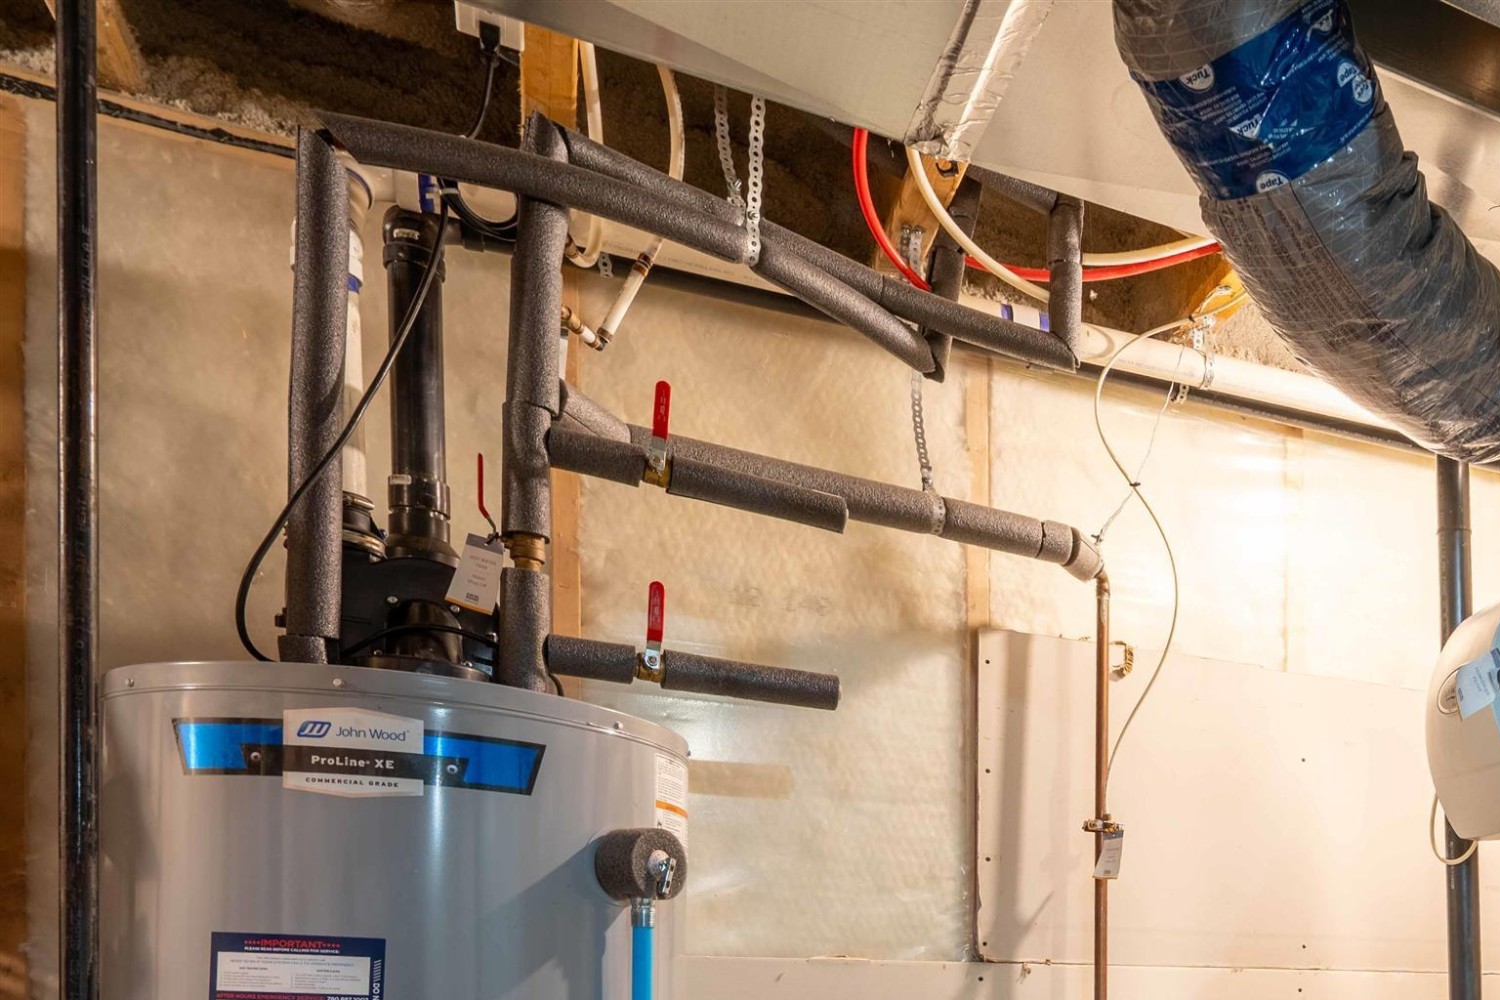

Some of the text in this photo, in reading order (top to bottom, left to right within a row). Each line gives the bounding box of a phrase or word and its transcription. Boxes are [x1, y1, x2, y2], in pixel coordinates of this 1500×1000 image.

[1185, 66, 1211, 86] Tuck
[336, 726, 406, 741] John Wood
[374, 759, 395, 769] XE
[305, 777, 364, 785] COMMERCIAL
[260, 939, 323, 949] IMPORTANT
